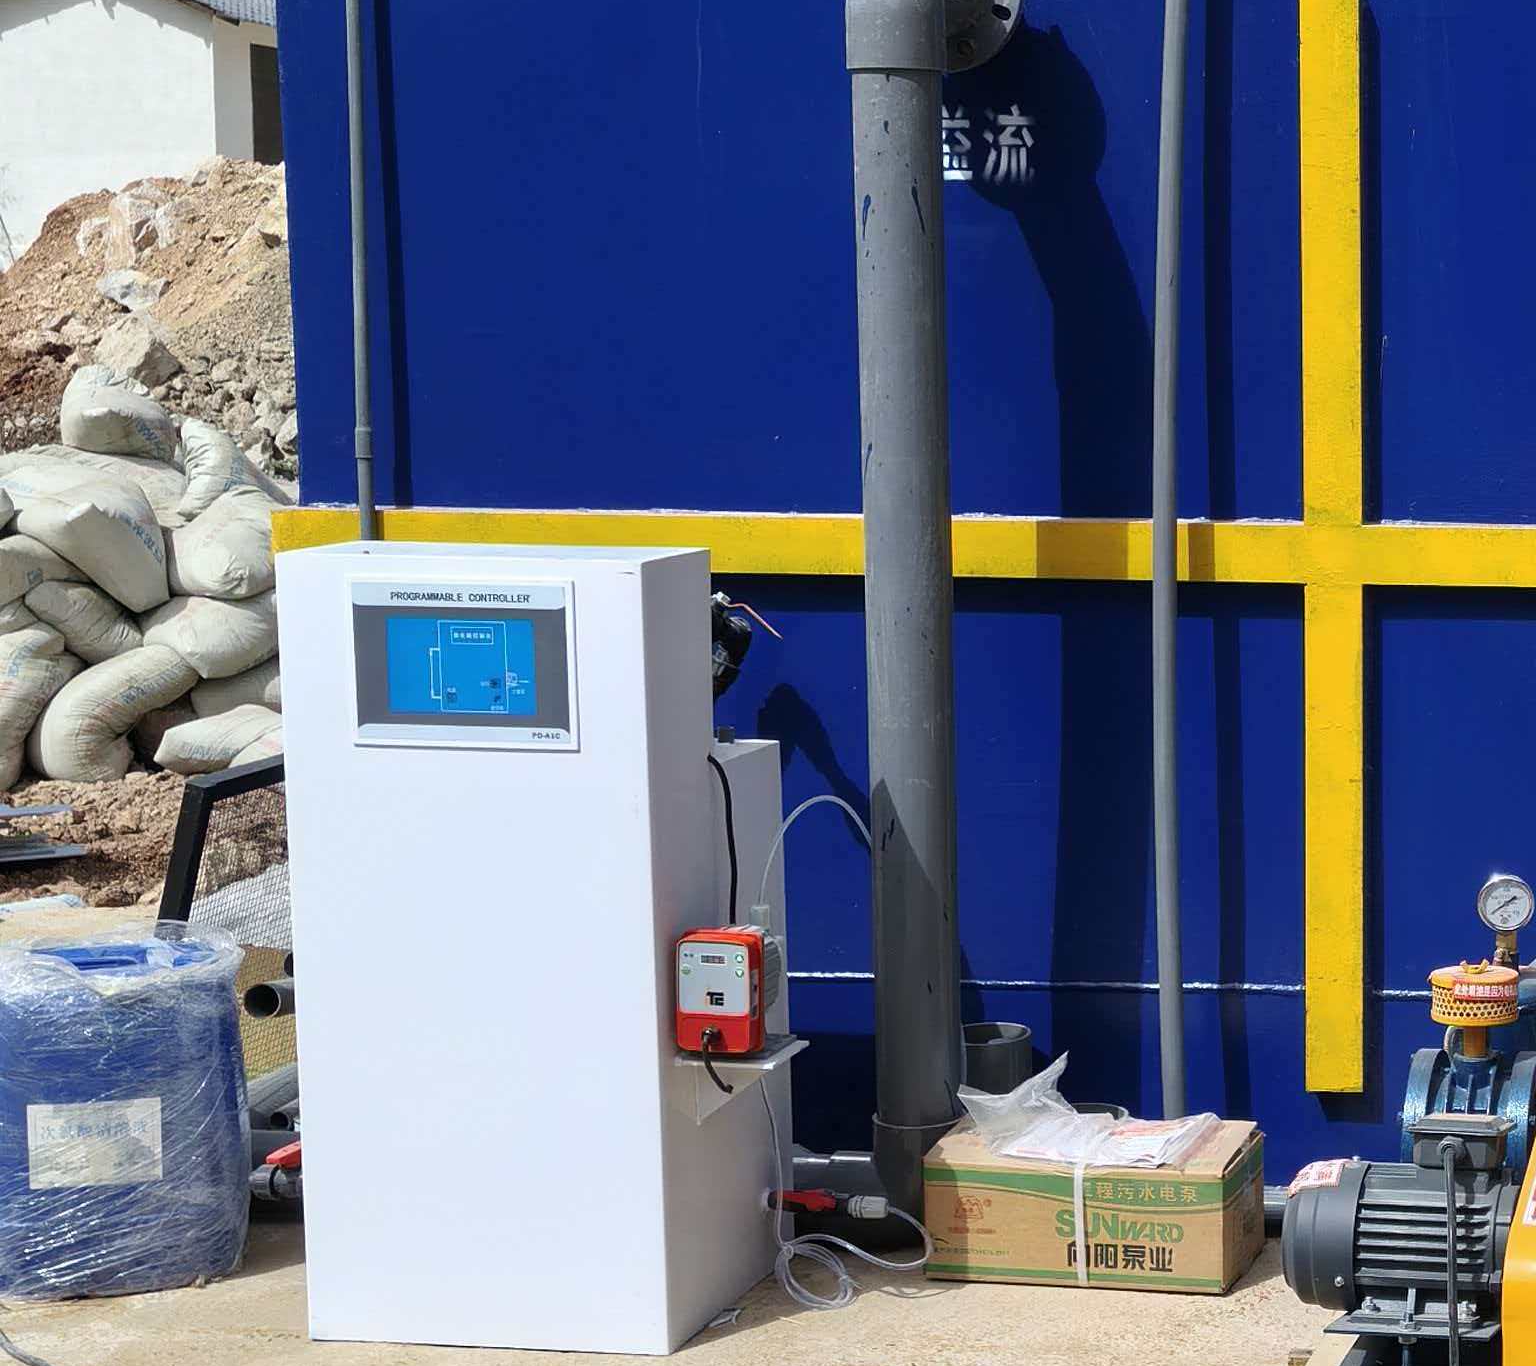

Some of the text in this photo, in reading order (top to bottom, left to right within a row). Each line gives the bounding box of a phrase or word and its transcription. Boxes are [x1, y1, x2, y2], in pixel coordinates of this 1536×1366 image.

[390, 592, 530, 604] PROGRAMMABLE CONTROLLER
[1055, 1209, 1184, 1243] SUNWARD
[1067, 1239, 1173, 1273] 向阳泵业
